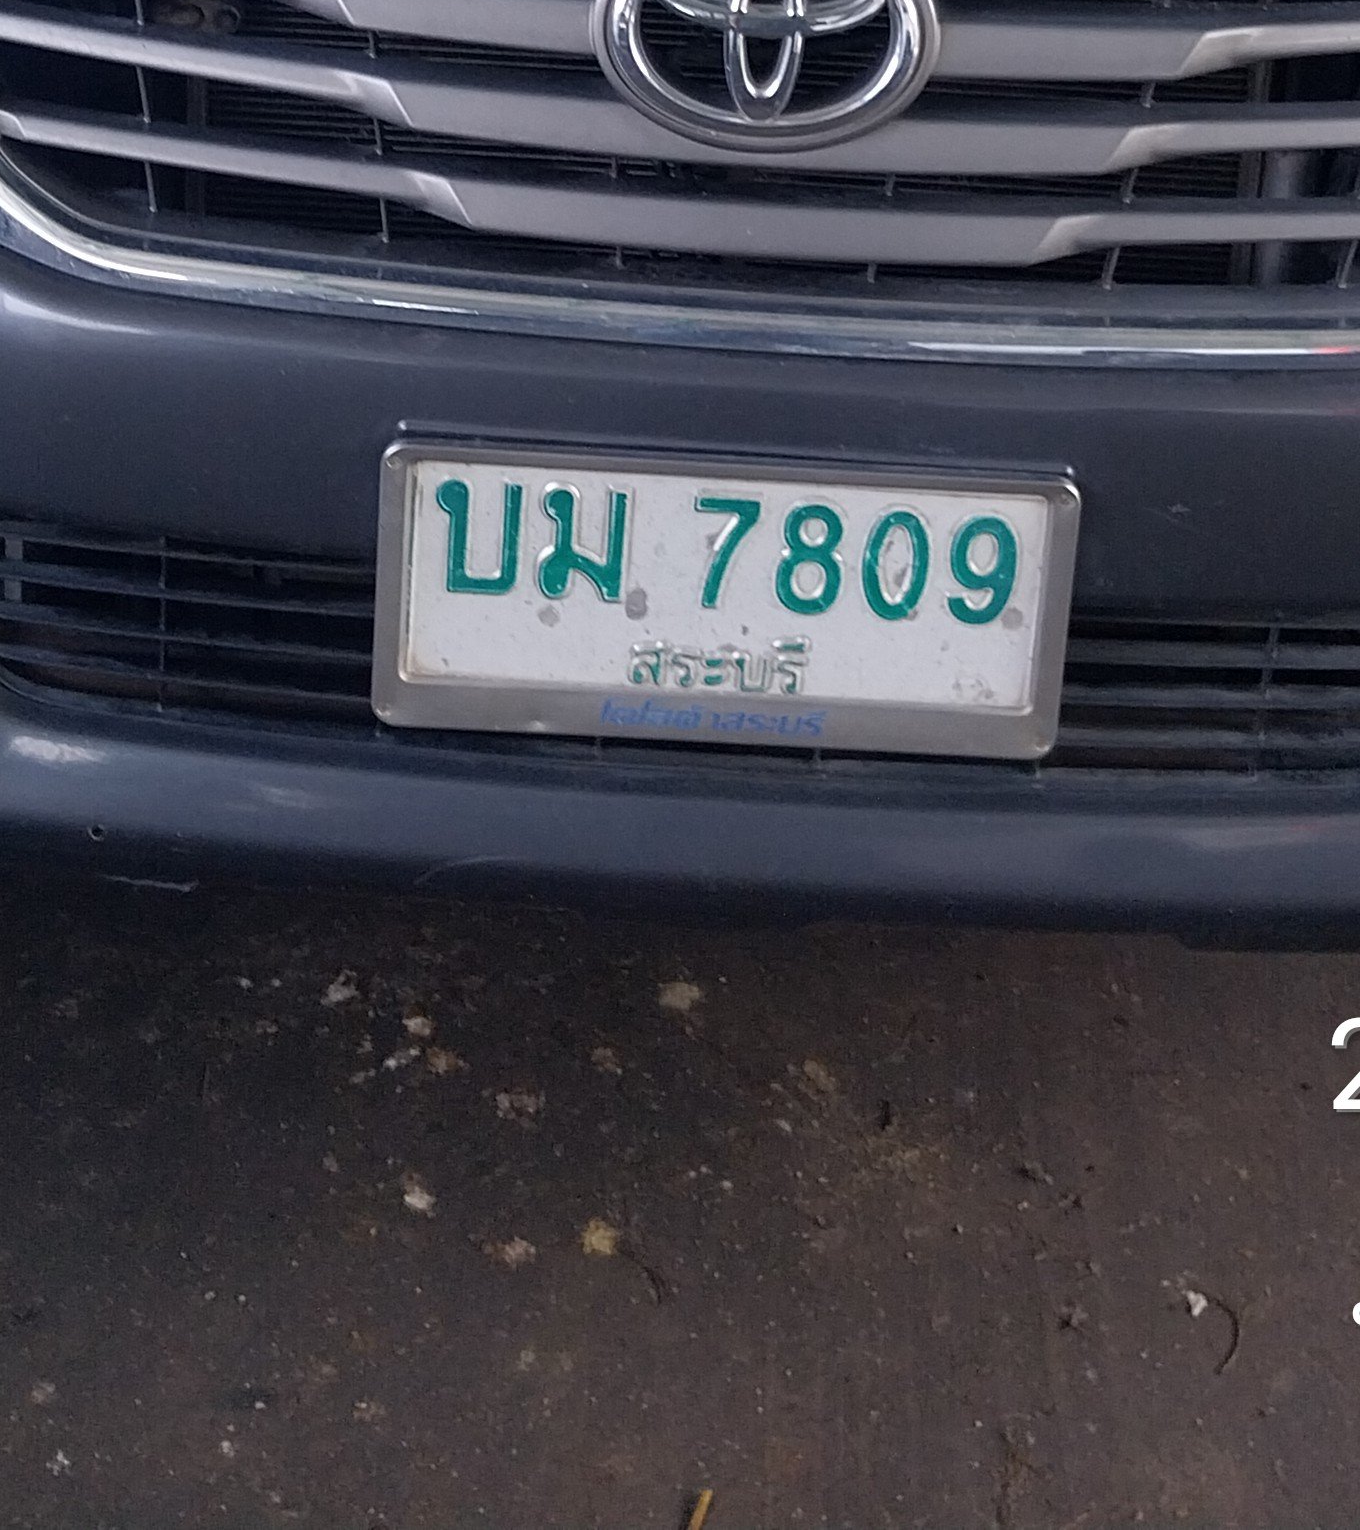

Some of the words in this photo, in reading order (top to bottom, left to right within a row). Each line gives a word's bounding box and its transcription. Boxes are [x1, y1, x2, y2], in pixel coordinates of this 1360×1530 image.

[435, 478, 630, 603] บม
[694, 494, 1019, 625] 7809
[628, 636, 810, 695] สระบรี
